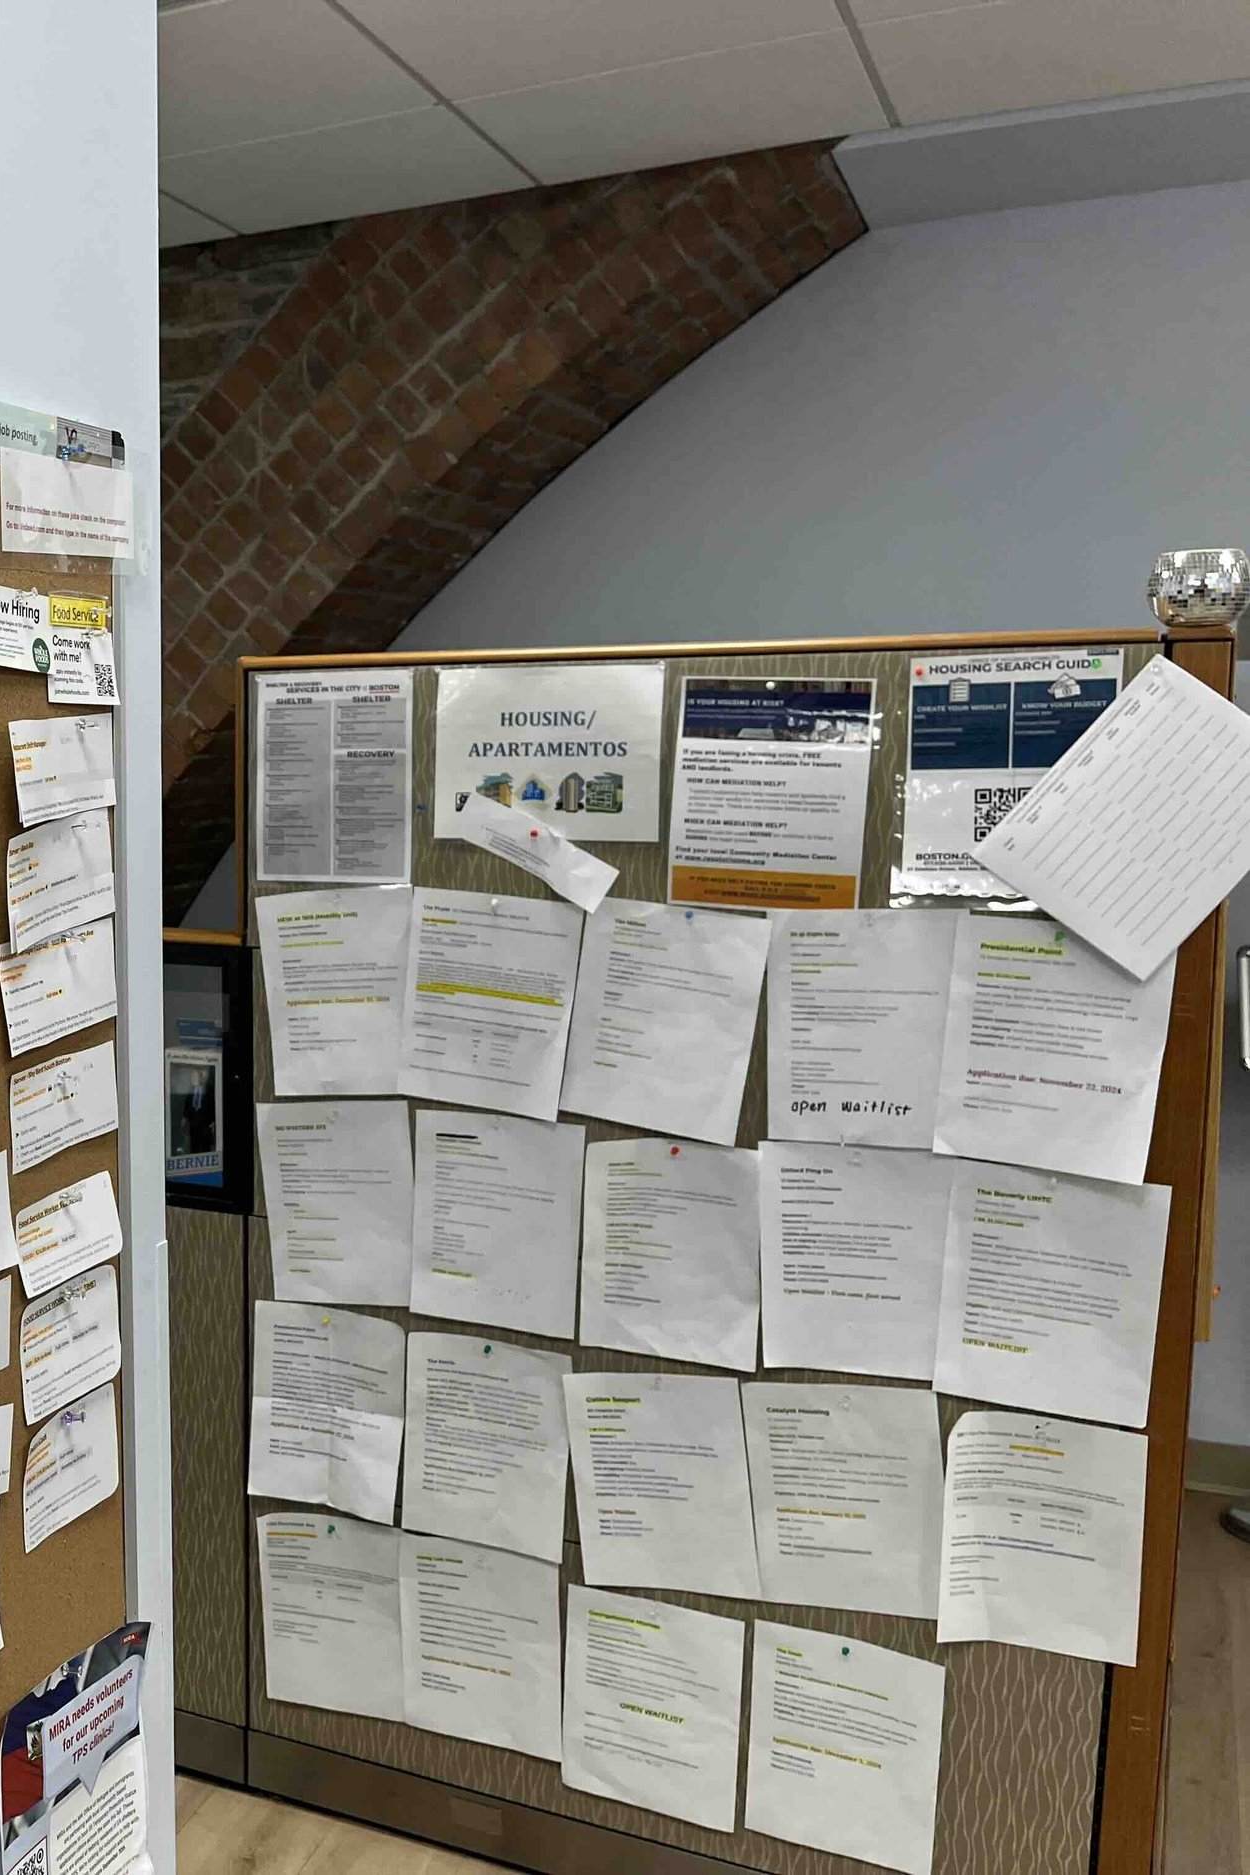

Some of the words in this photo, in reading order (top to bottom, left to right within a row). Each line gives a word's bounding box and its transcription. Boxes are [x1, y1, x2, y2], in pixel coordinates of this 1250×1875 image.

[11, 429, 38, 446] posting,
[12, 599, 40, 624] Hiring
[53, 605, 70, 620] Food
[72, 608, 98, 622] Service
[52, 635, 72, 646] Come
[74, 638, 90, 650] work
[54, 650, 67, 661] with
[69, 652, 81, 662] me!
[929, 663, 992, 675] HOUSING
[995, 660, 1052, 672] SEARCH
[352, 695, 391, 703] SHELTER
[500, 711, 596, 729] HOUSING/
[468, 742, 627, 757] APARTAMENTOS
[167, 1154, 219, 1172] BERNIE
[49, 1716, 70, 1741] MIRA
[72, 1701, 95, 1725] needs
[96, 1668, 133, 1704] volunteers
[63, 1737, 74, 1752] for
[75, 1727, 88, 1743] our
[90, 1696, 124, 1730] upcoming
[72, 1743, 88, 1765] TPS
[89, 1720, 115, 1751] clinics!
